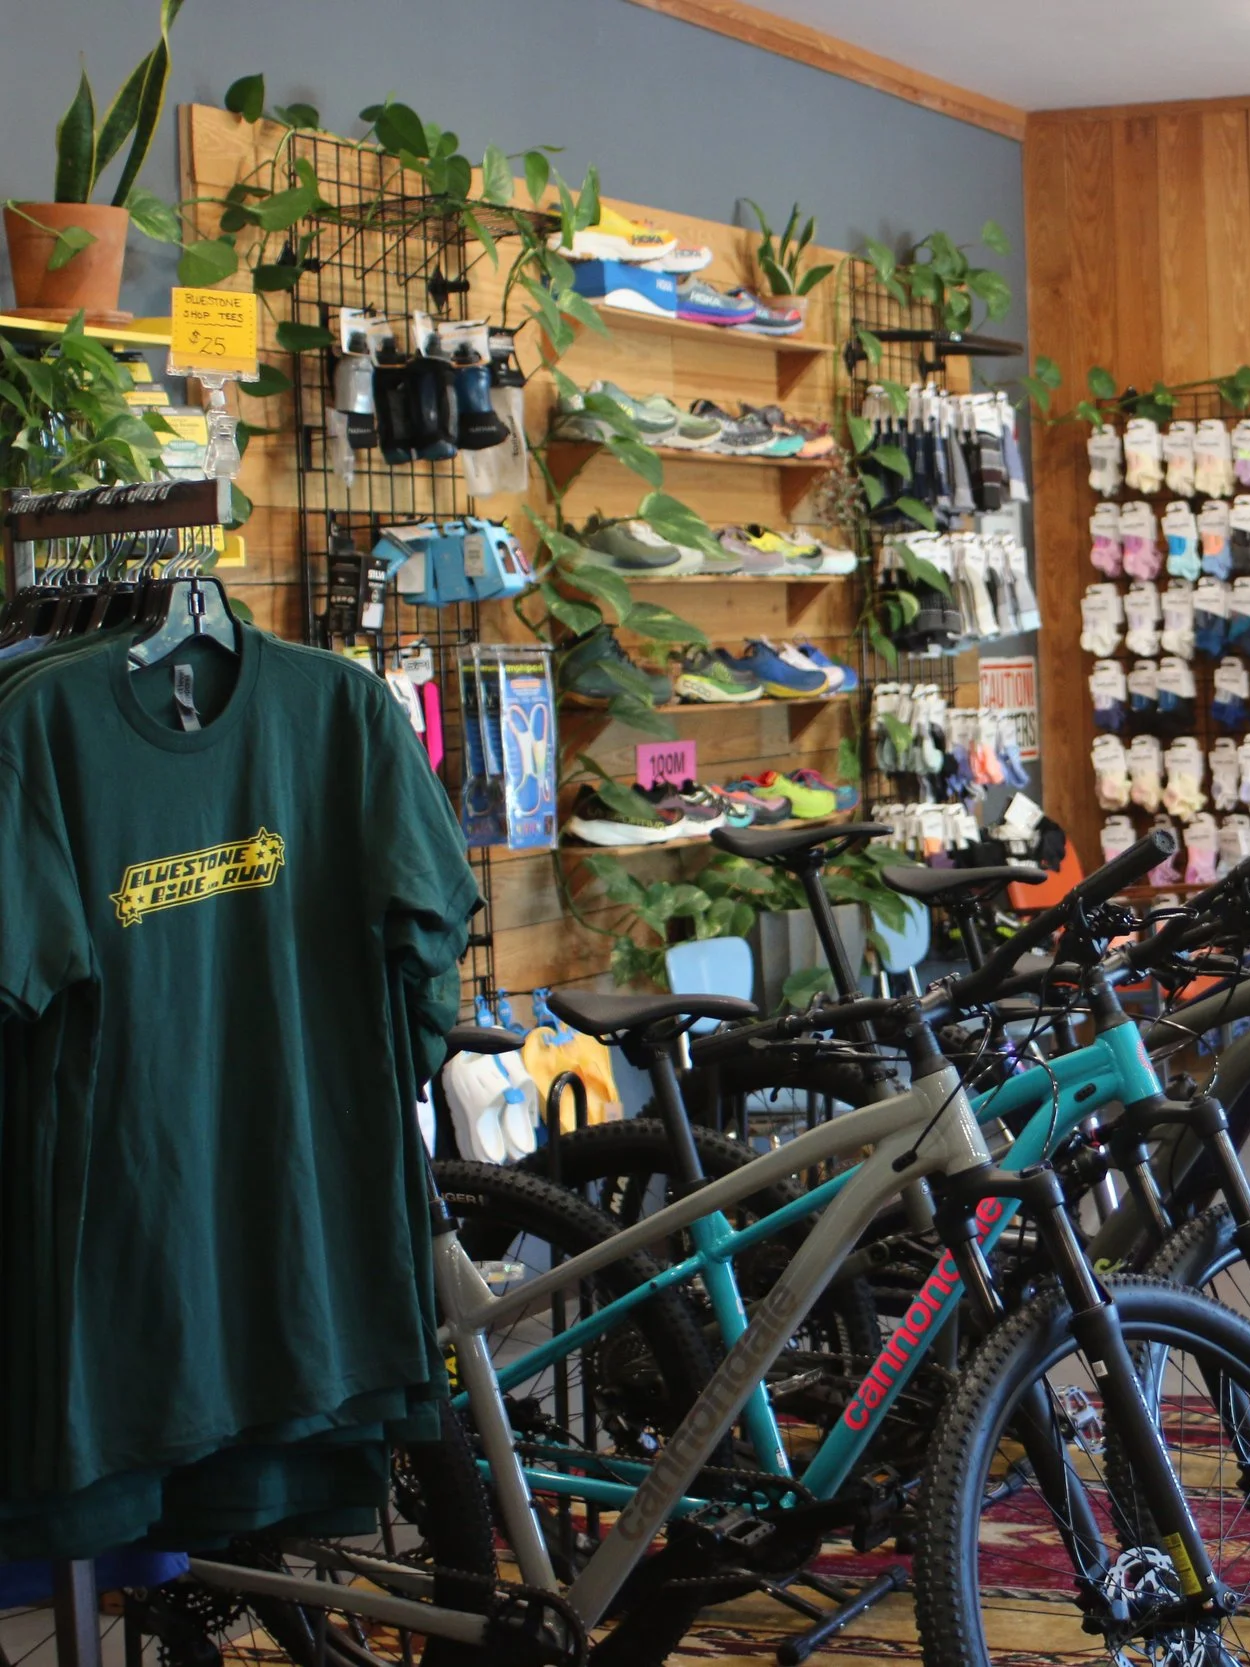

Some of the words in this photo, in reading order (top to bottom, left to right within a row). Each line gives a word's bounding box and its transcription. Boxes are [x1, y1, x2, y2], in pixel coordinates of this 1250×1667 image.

[185, 293, 242, 308] BLUESTONE
[183, 310, 210, 320] SHOP
[218, 312, 244, 323] TEES
[188, 330, 226, 356] $25
[650, 752, 685, 775] 100M
[130, 846, 251, 890] BLUESTONE
[151, 875, 208, 904] BIKE
[222, 863, 273, 885] RUN
